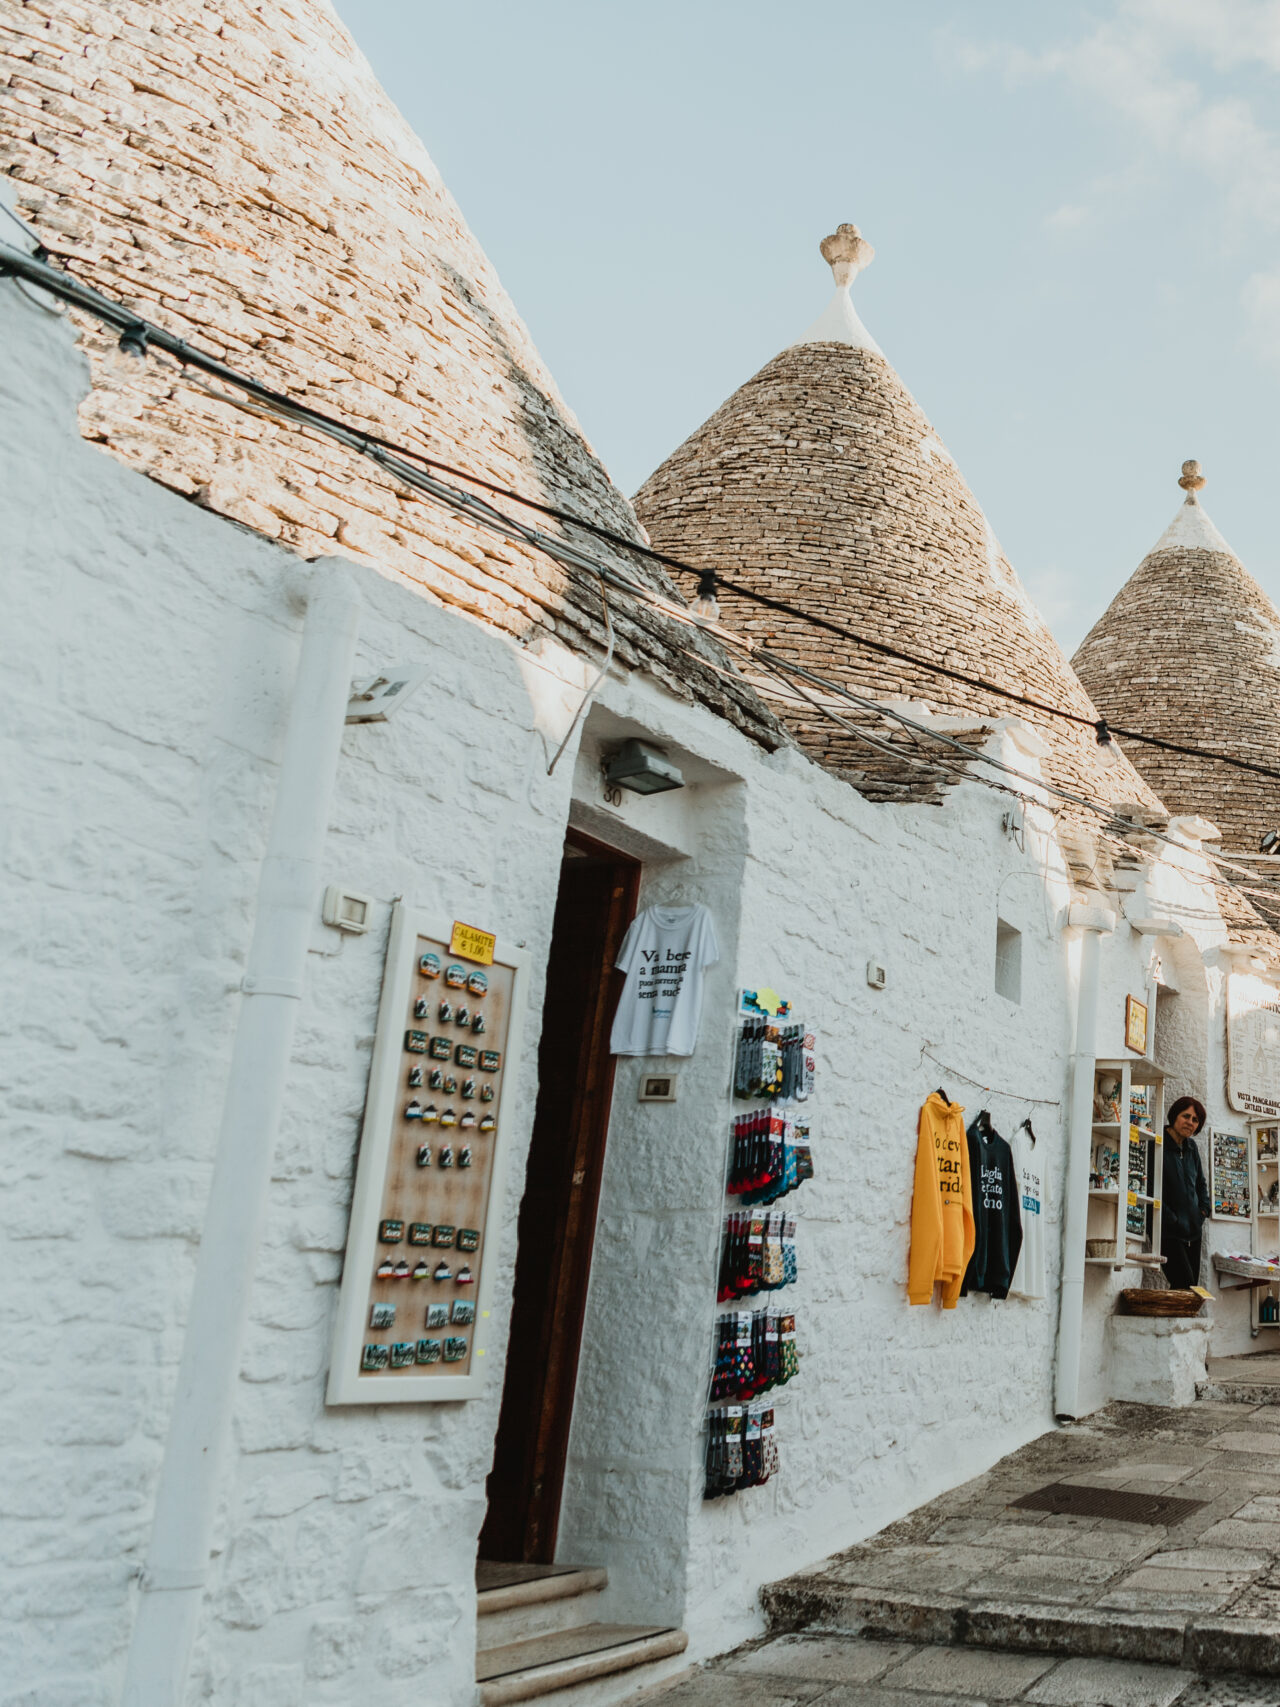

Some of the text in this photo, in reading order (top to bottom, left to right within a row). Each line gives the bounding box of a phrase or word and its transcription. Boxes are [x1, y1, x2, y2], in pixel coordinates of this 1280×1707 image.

[455, 927, 493, 947] CALAMITE
[640, 966, 646, 975] a
[1237, 1092, 1251, 1102] VISTA
